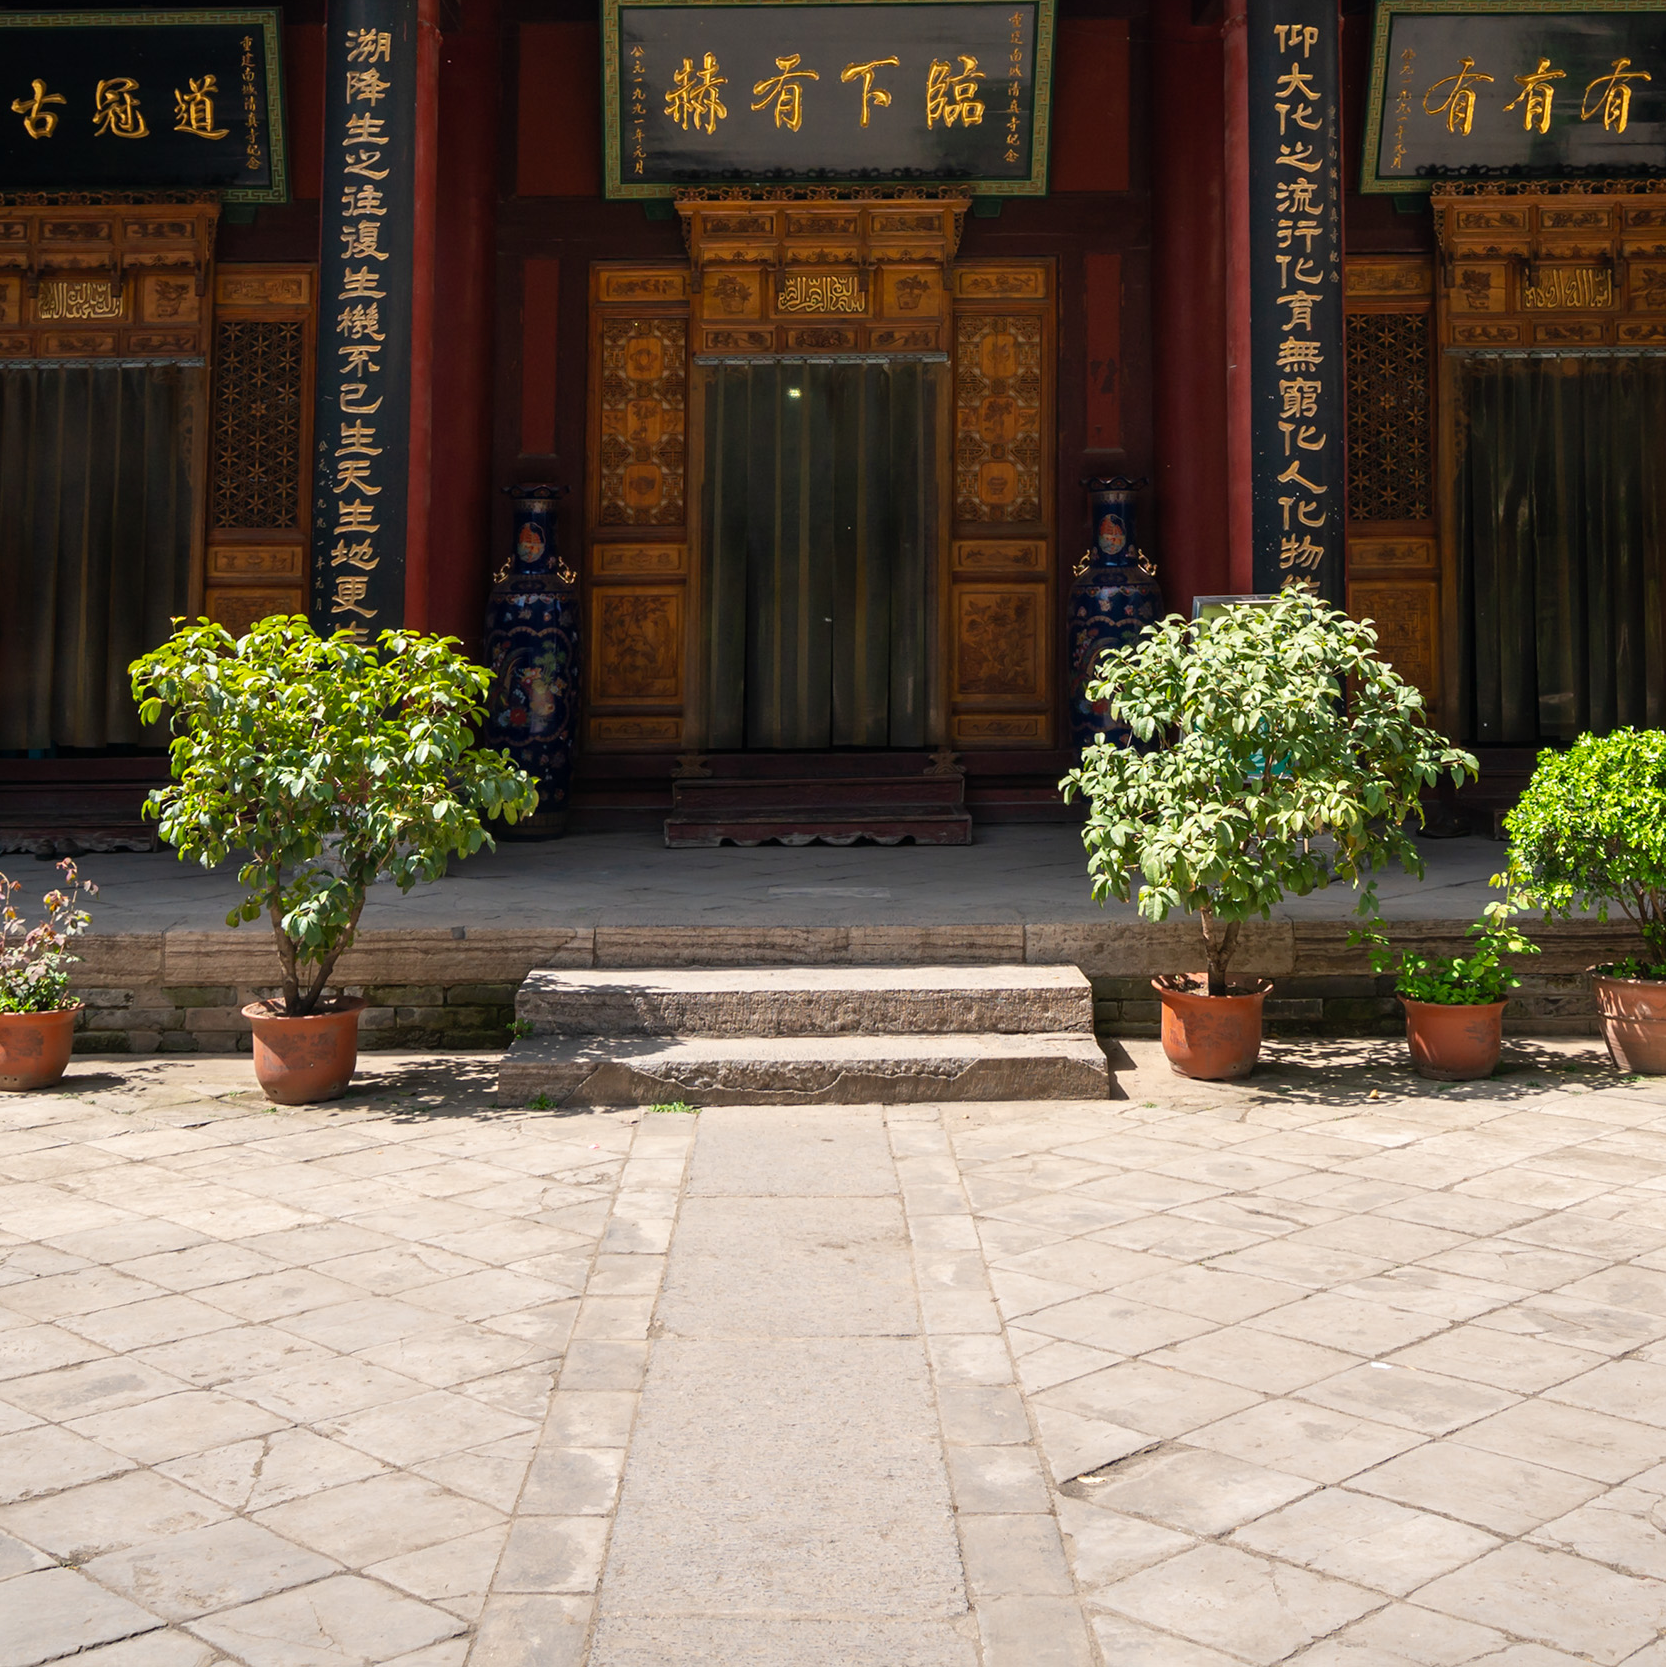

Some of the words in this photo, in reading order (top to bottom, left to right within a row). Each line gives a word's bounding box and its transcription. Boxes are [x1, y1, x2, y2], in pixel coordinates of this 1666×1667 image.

[630, 45, 647, 175] 公元一九九一年元月
